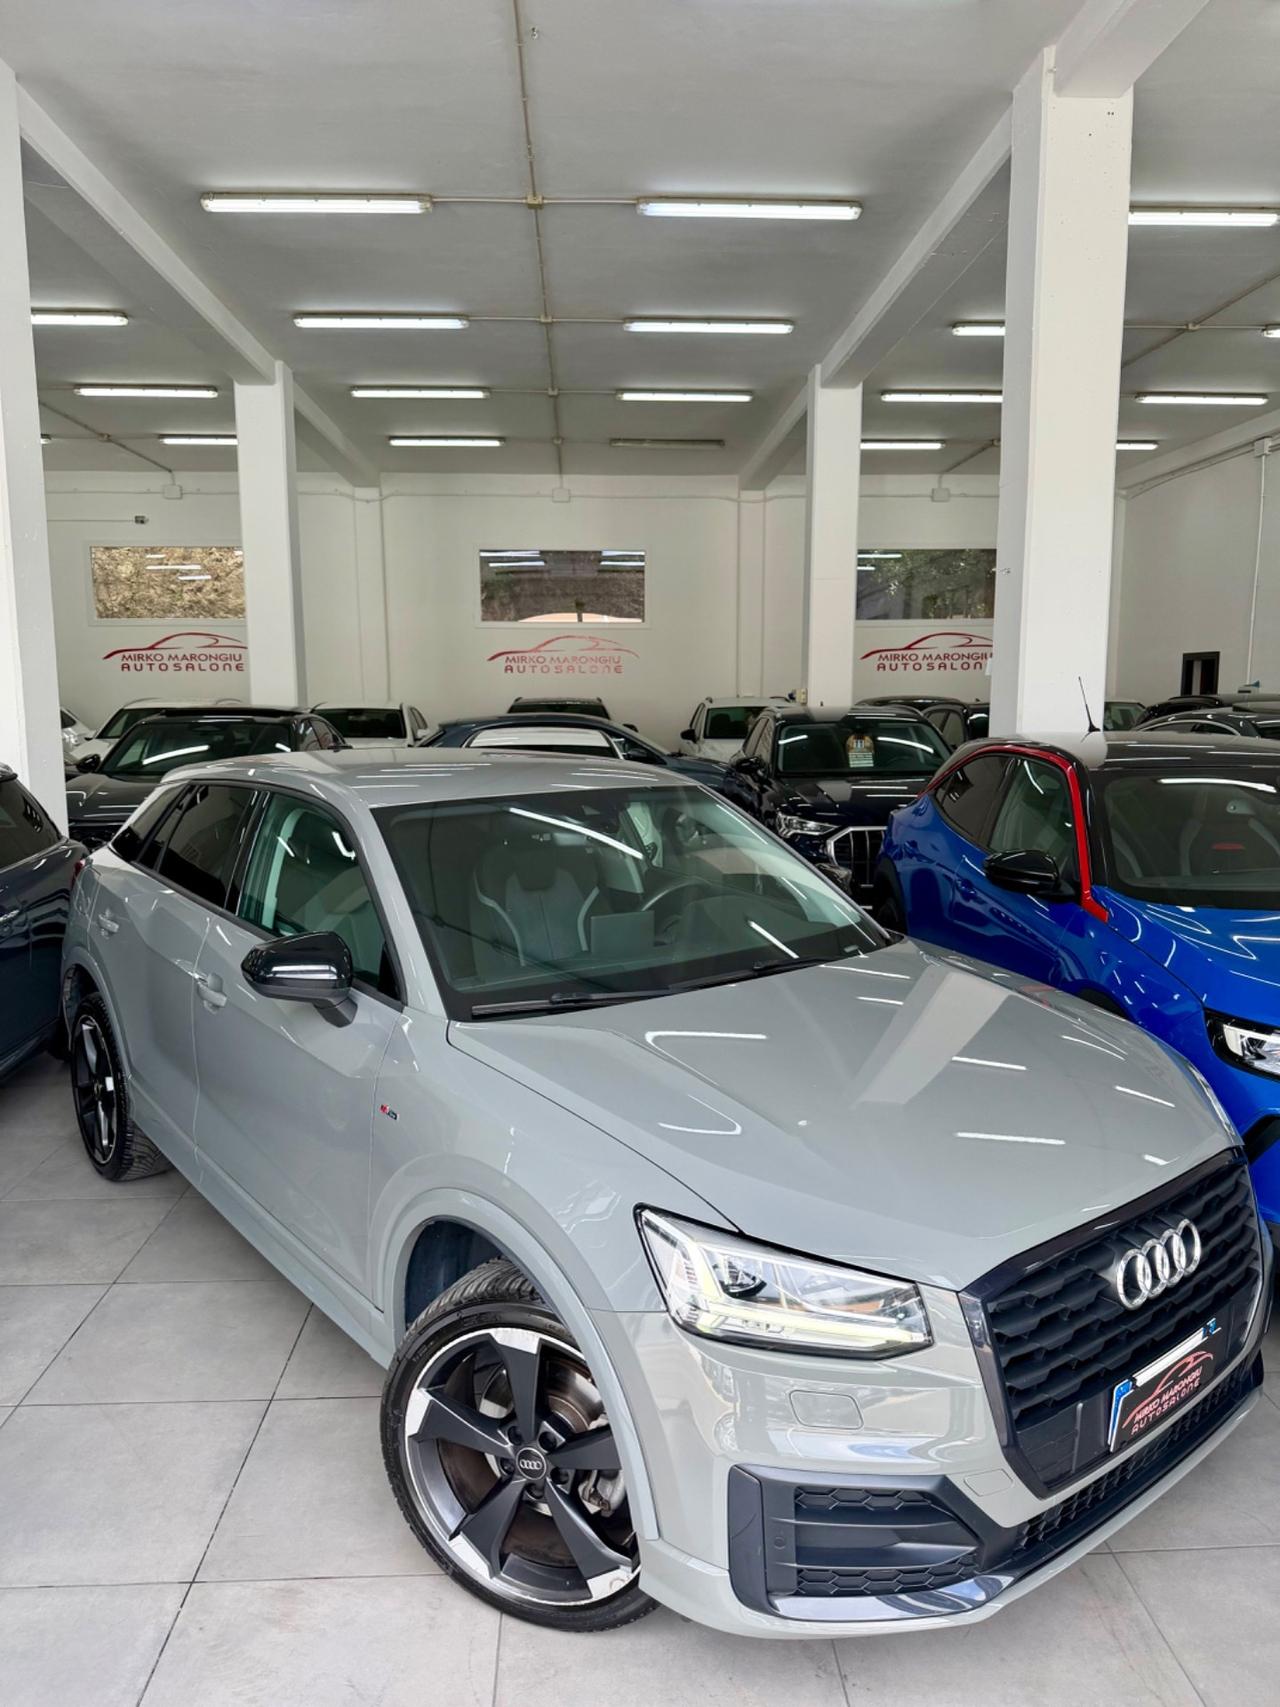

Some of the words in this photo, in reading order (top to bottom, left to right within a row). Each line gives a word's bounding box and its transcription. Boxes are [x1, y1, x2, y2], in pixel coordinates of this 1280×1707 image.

[121, 653, 164, 662] MIRKO
[167, 653, 242, 662] MARONGIU
[504, 656, 546, 664] MIRKO
[550, 656, 621, 664] MARONGIU
[878, 653, 919, 662] MIRKO
[121, 662, 245, 672] AUTOSALONE
[504, 664, 623, 674] AUTOSALONE
[1131, 1377, 1201, 1435] AUTOSALONE
[1134, 1399, 1160, 1424] MIRKO
